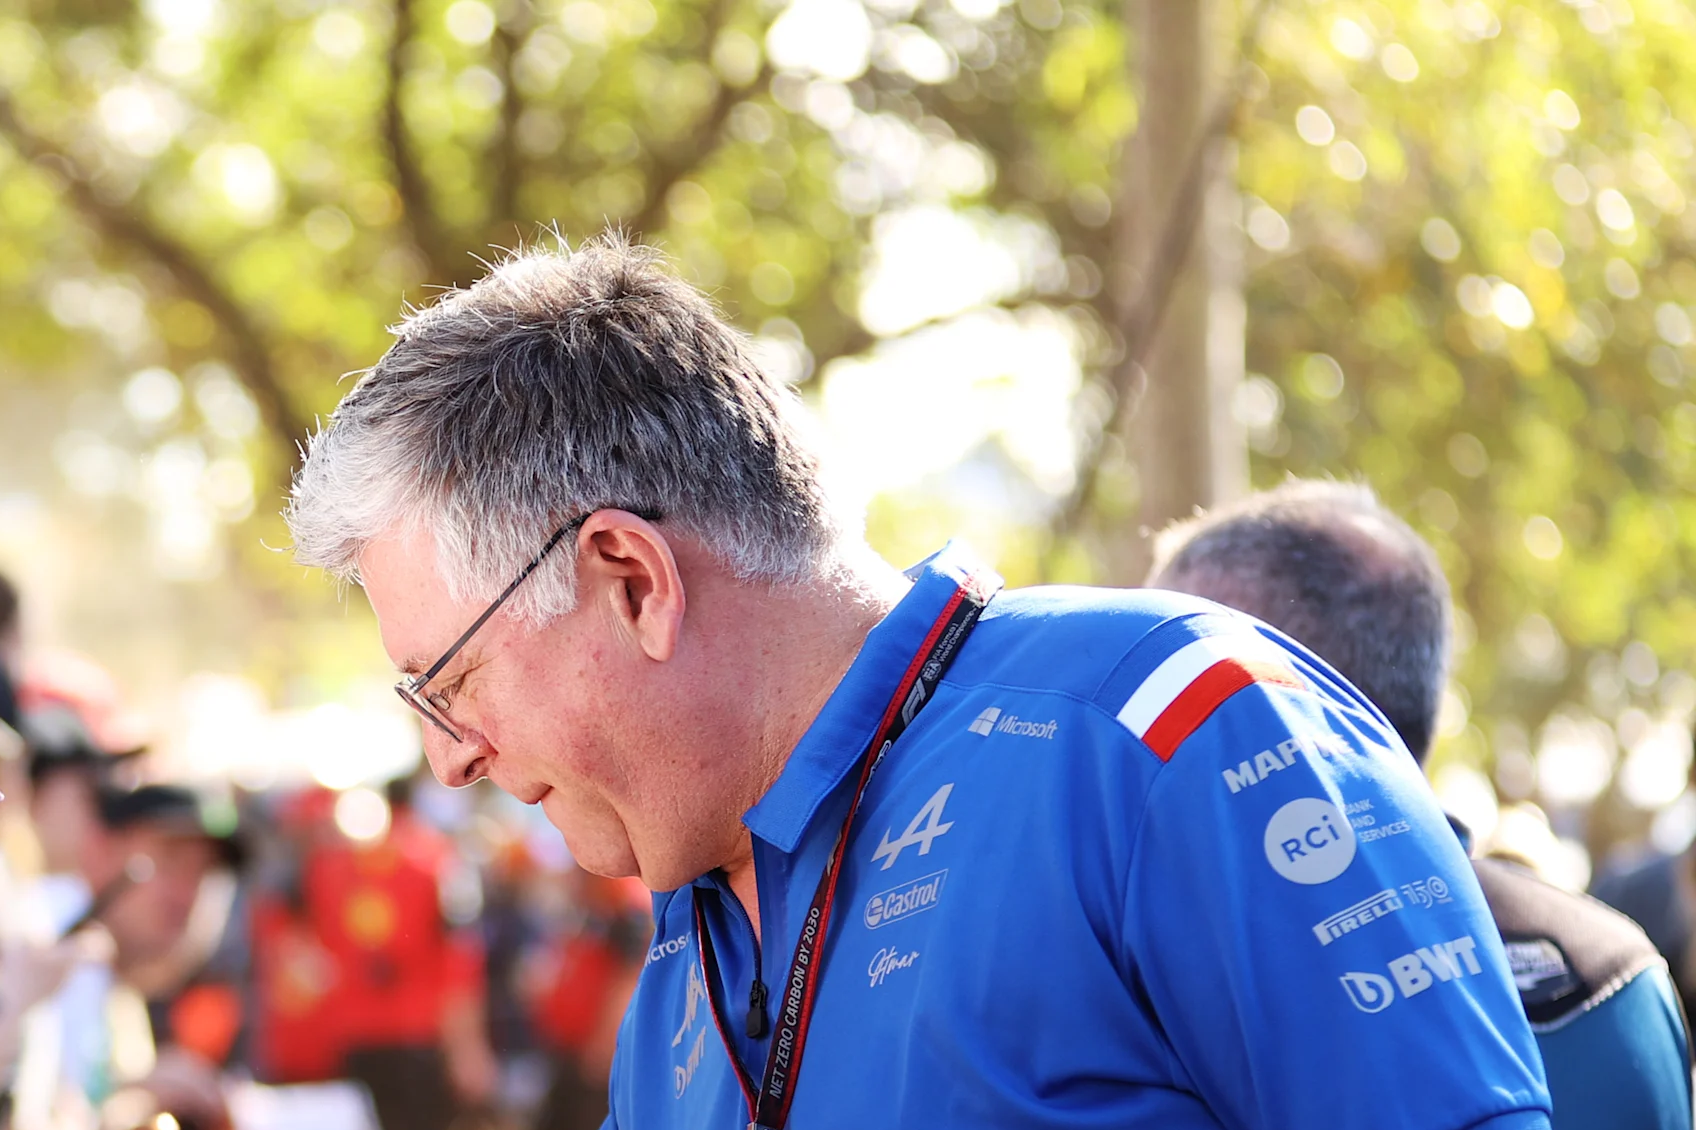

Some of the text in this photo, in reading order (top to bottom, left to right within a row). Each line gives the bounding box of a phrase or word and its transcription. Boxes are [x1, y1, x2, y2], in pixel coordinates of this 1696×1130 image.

[995, 714, 1059, 740] Microsoft
[1358, 819, 1412, 843] SERVICES
[883, 876, 941, 921] Castrol
[1312, 887, 1404, 946] PIRELLI
[1387, 935, 1483, 999] BWT
[769, 907, 820, 1099] NET ZERO CARBON BY 2030
